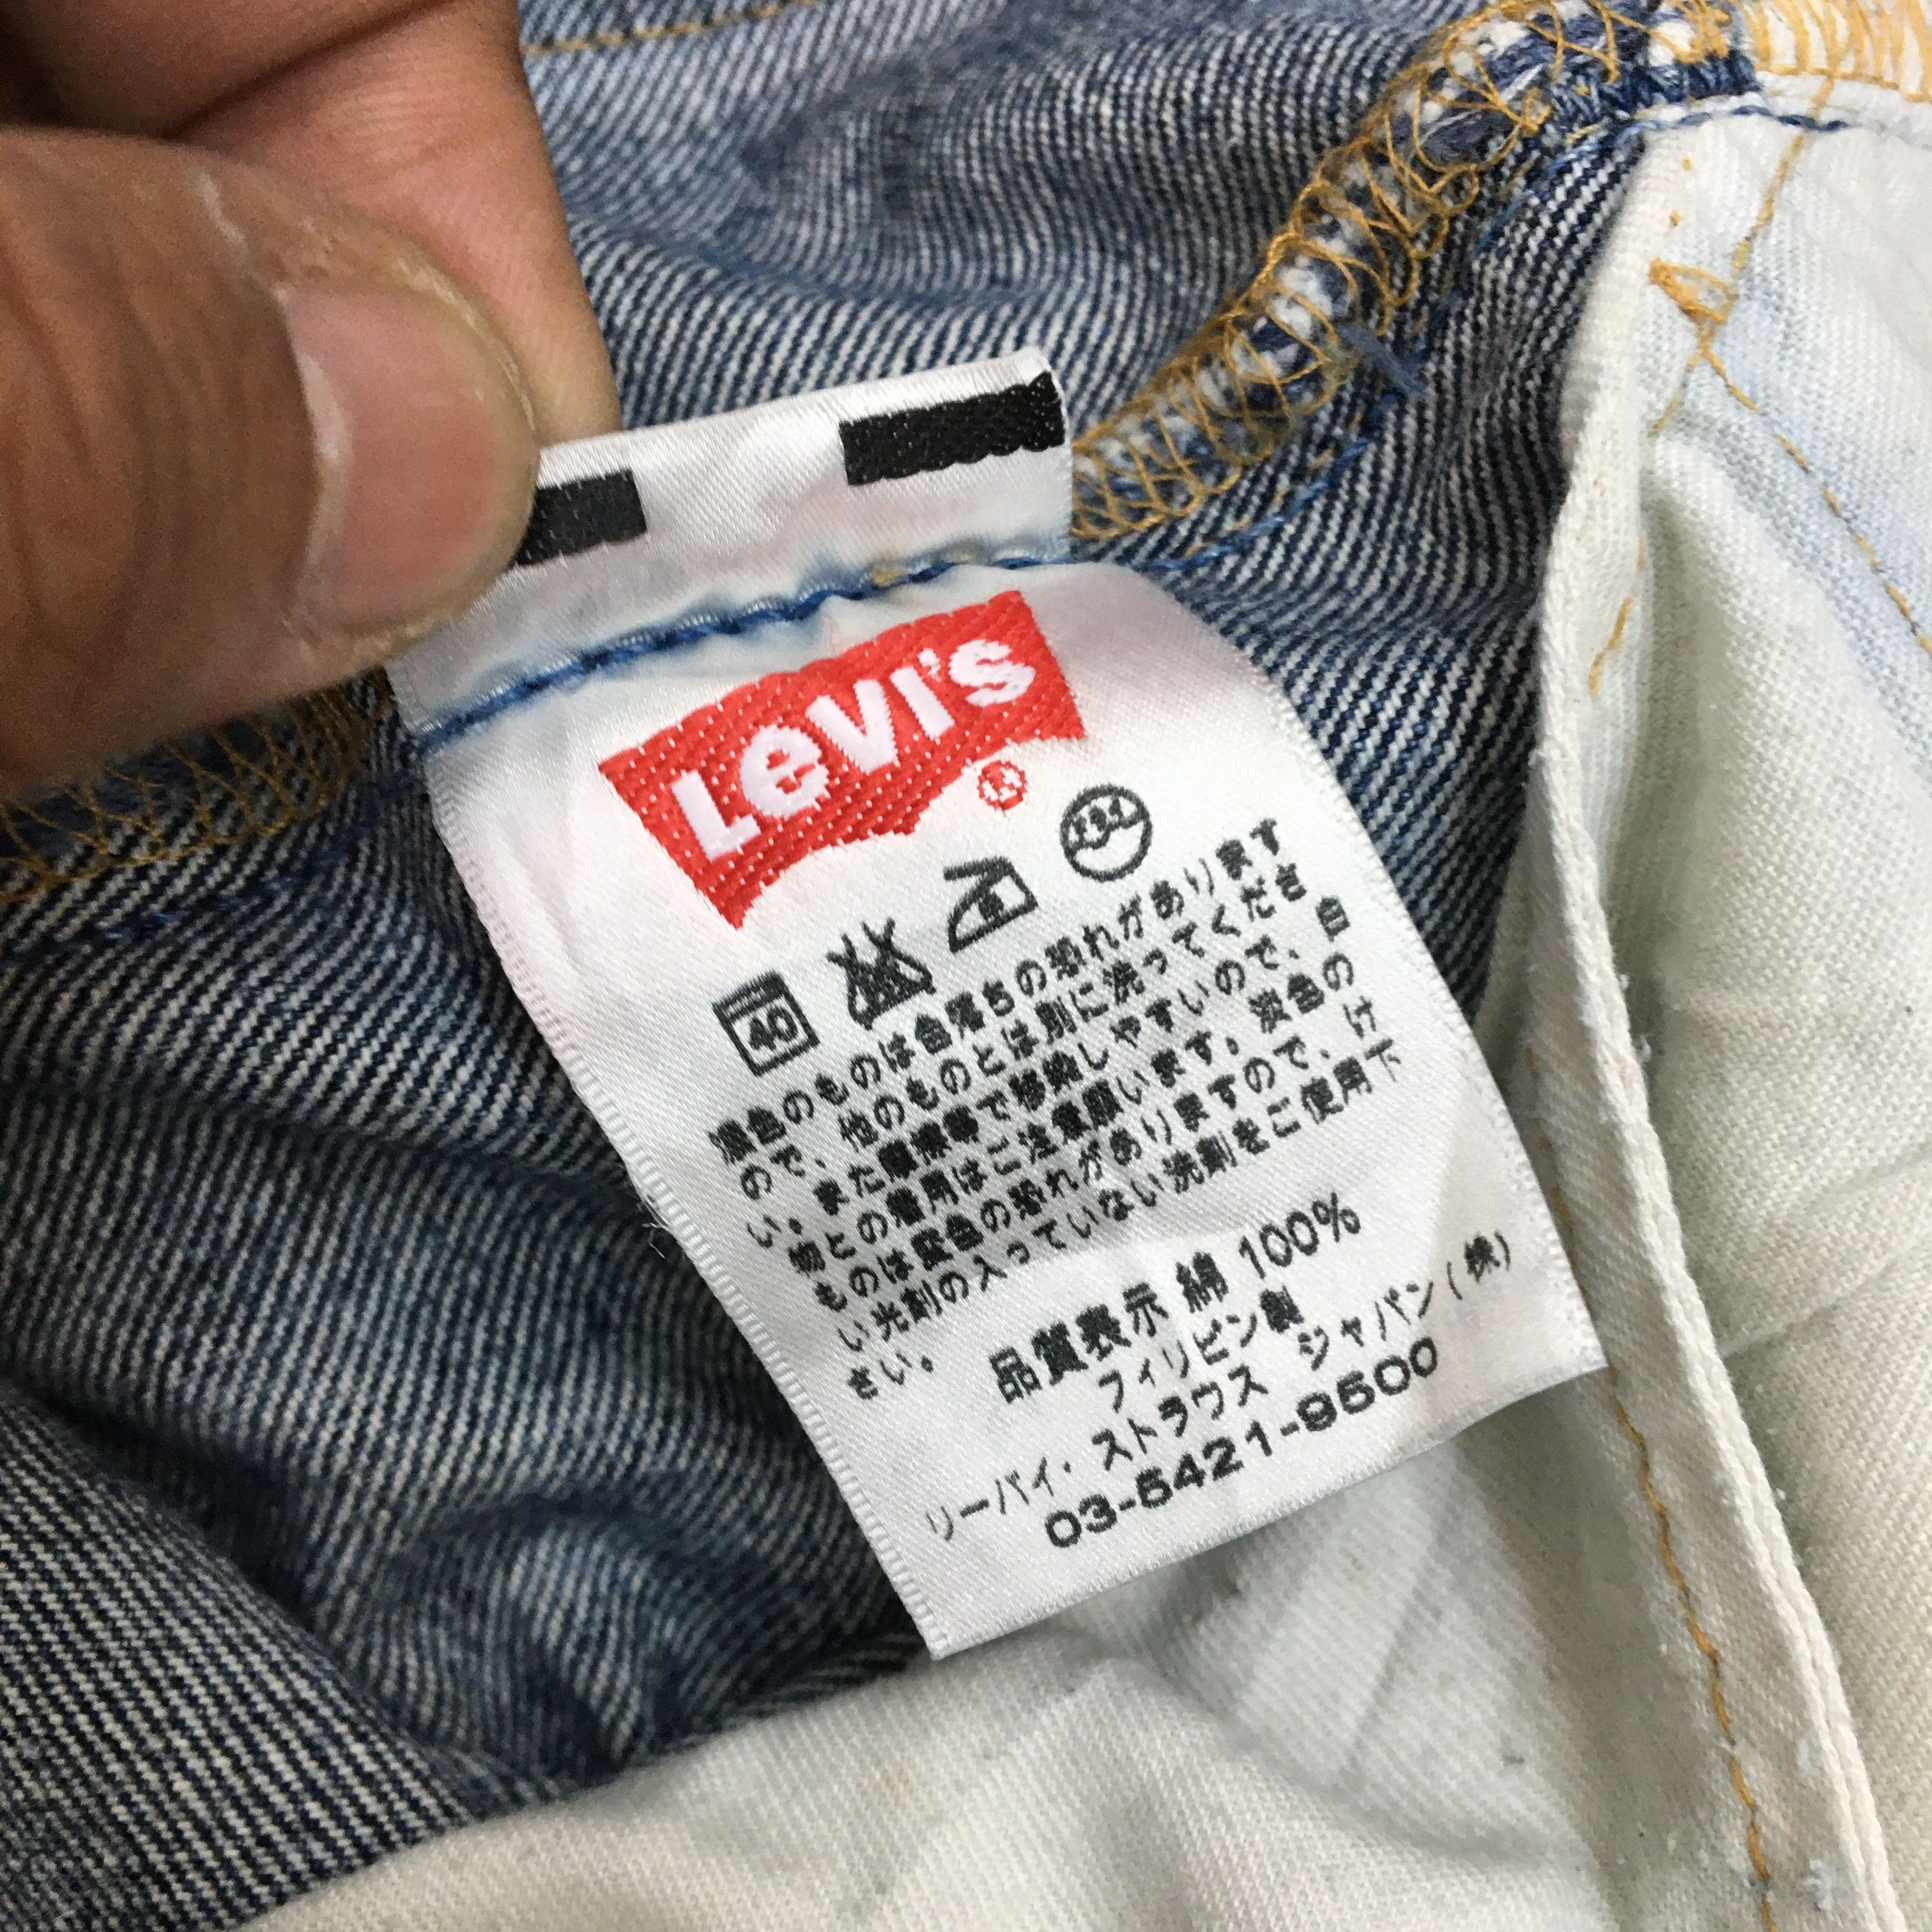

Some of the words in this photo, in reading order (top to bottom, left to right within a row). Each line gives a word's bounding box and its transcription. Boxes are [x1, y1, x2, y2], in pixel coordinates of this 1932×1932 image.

[748, 1006, 798, 1052] 40
[987, 1281, 1169, 1405] 品質表示
[1176, 1251, 1229, 1314] 綿
[1238, 1192, 1361, 1280] 100%
[1097, 1284, 1305, 1414] フィリピン製
[846, 1352, 934, 1400] さい。
[1091, 1363, 1269, 1472] ストラウス
